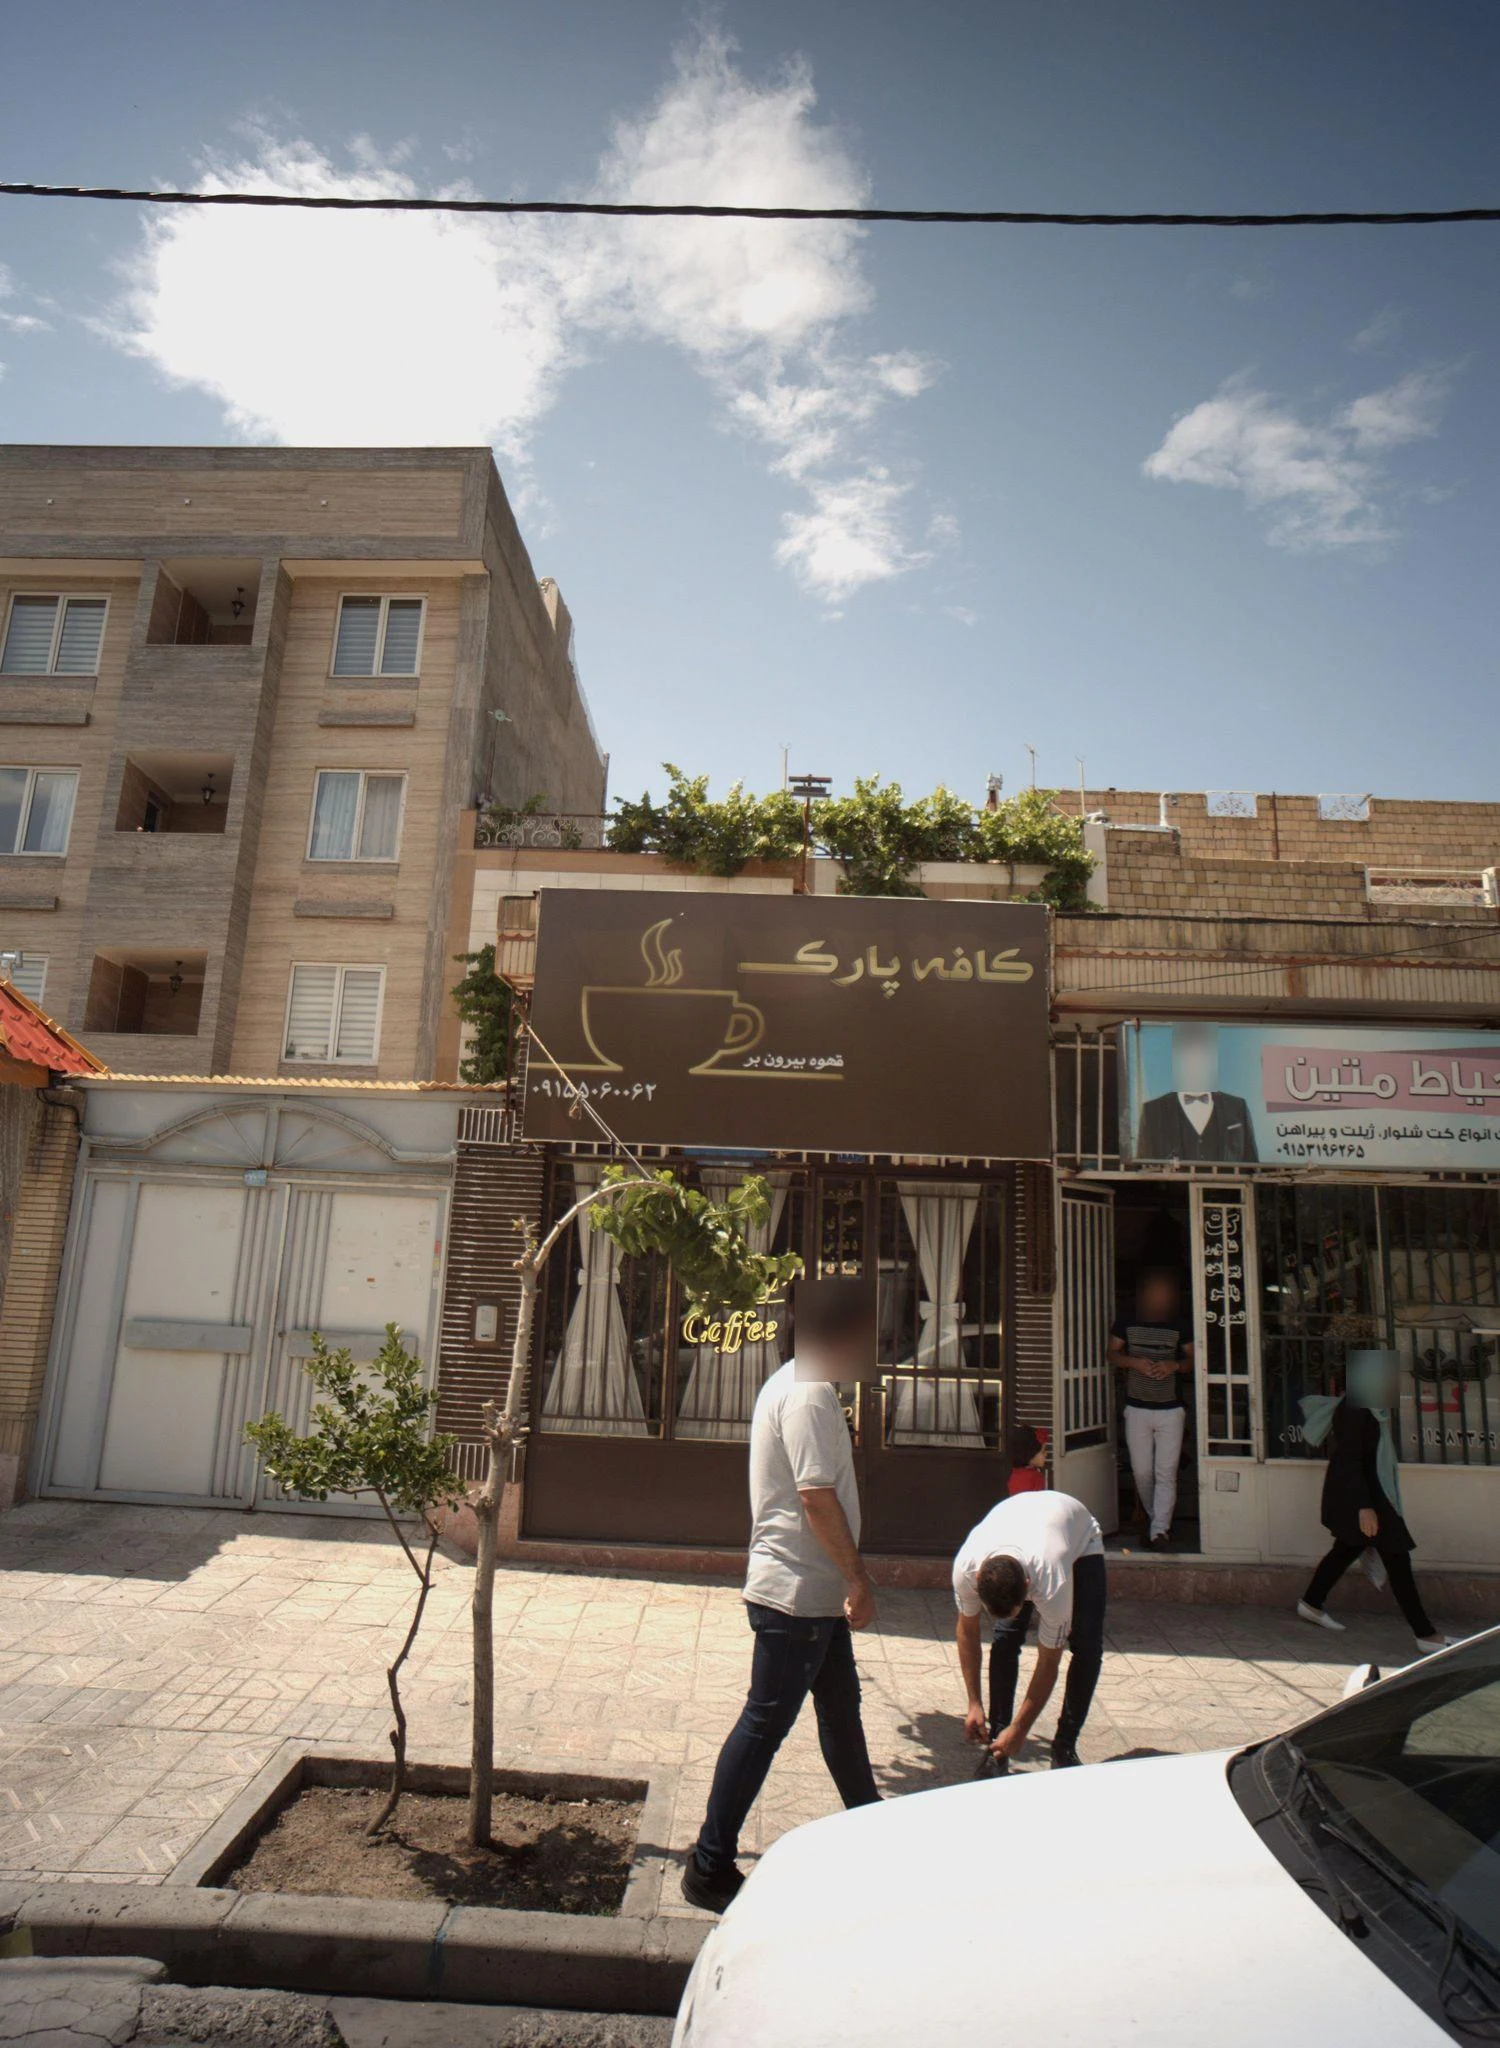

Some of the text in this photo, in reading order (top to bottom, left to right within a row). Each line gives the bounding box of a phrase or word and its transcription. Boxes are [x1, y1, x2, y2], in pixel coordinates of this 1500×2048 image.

[738, 940, 1034, 998] کافه پارک
[743, 1053, 844, 1070] قهوه بیرون بر
[1284, 1057, 1500, 1106] یاط متین
[1276, 1124, 1325, 1140] پیراهن
[1329, 1127, 1338, 1138] و
[1341, 1123, 1375, 1139] ژیلت
[1426, 1128, 1454, 1139] کت
[1458, 1128, 1491, 1142] انواع
[683, 1310, 778, 1353] Coffee
